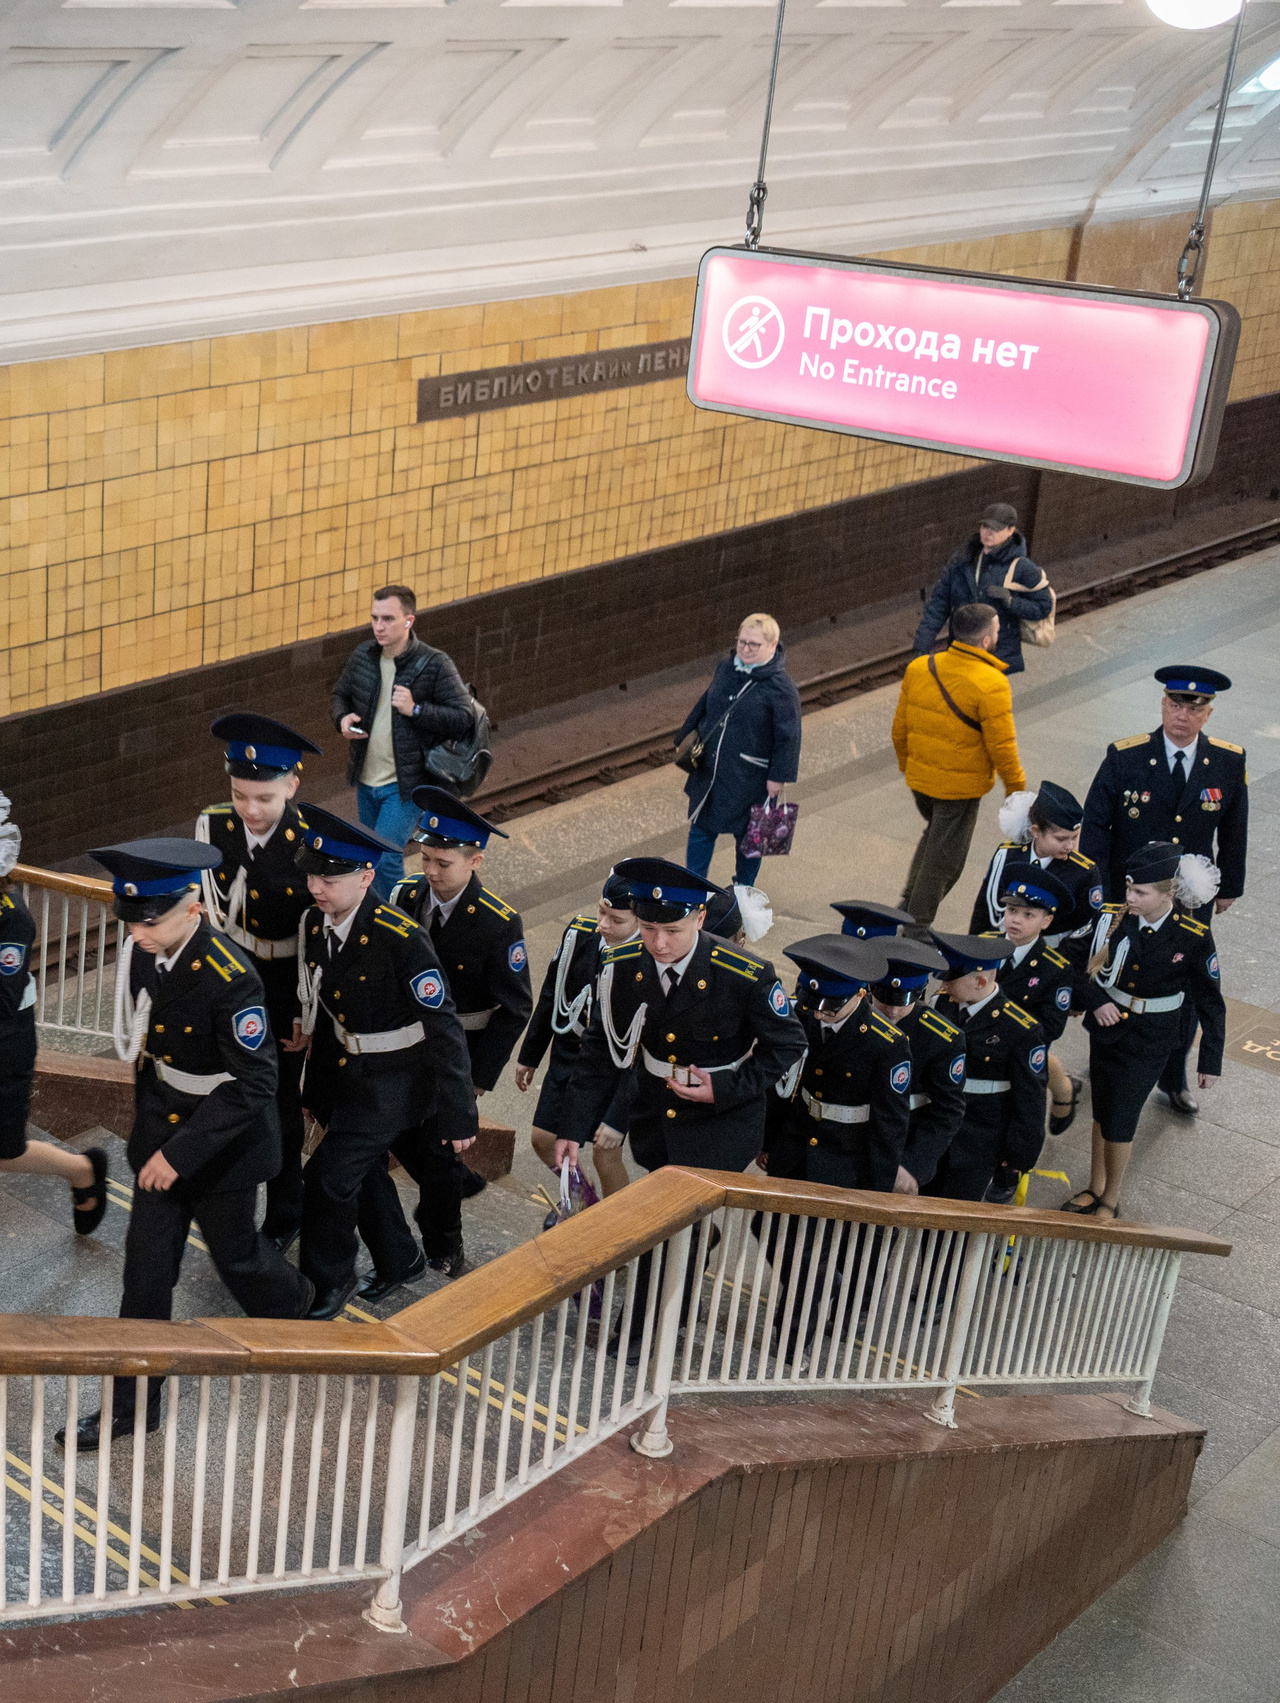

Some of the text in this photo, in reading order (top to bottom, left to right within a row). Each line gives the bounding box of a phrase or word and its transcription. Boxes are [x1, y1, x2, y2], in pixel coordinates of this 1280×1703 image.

[803, 306, 1040, 370] Прохода нет
[438, 358, 607, 408] БИБЛИОТЕКА
[799, 352, 958, 399] No Entrance
